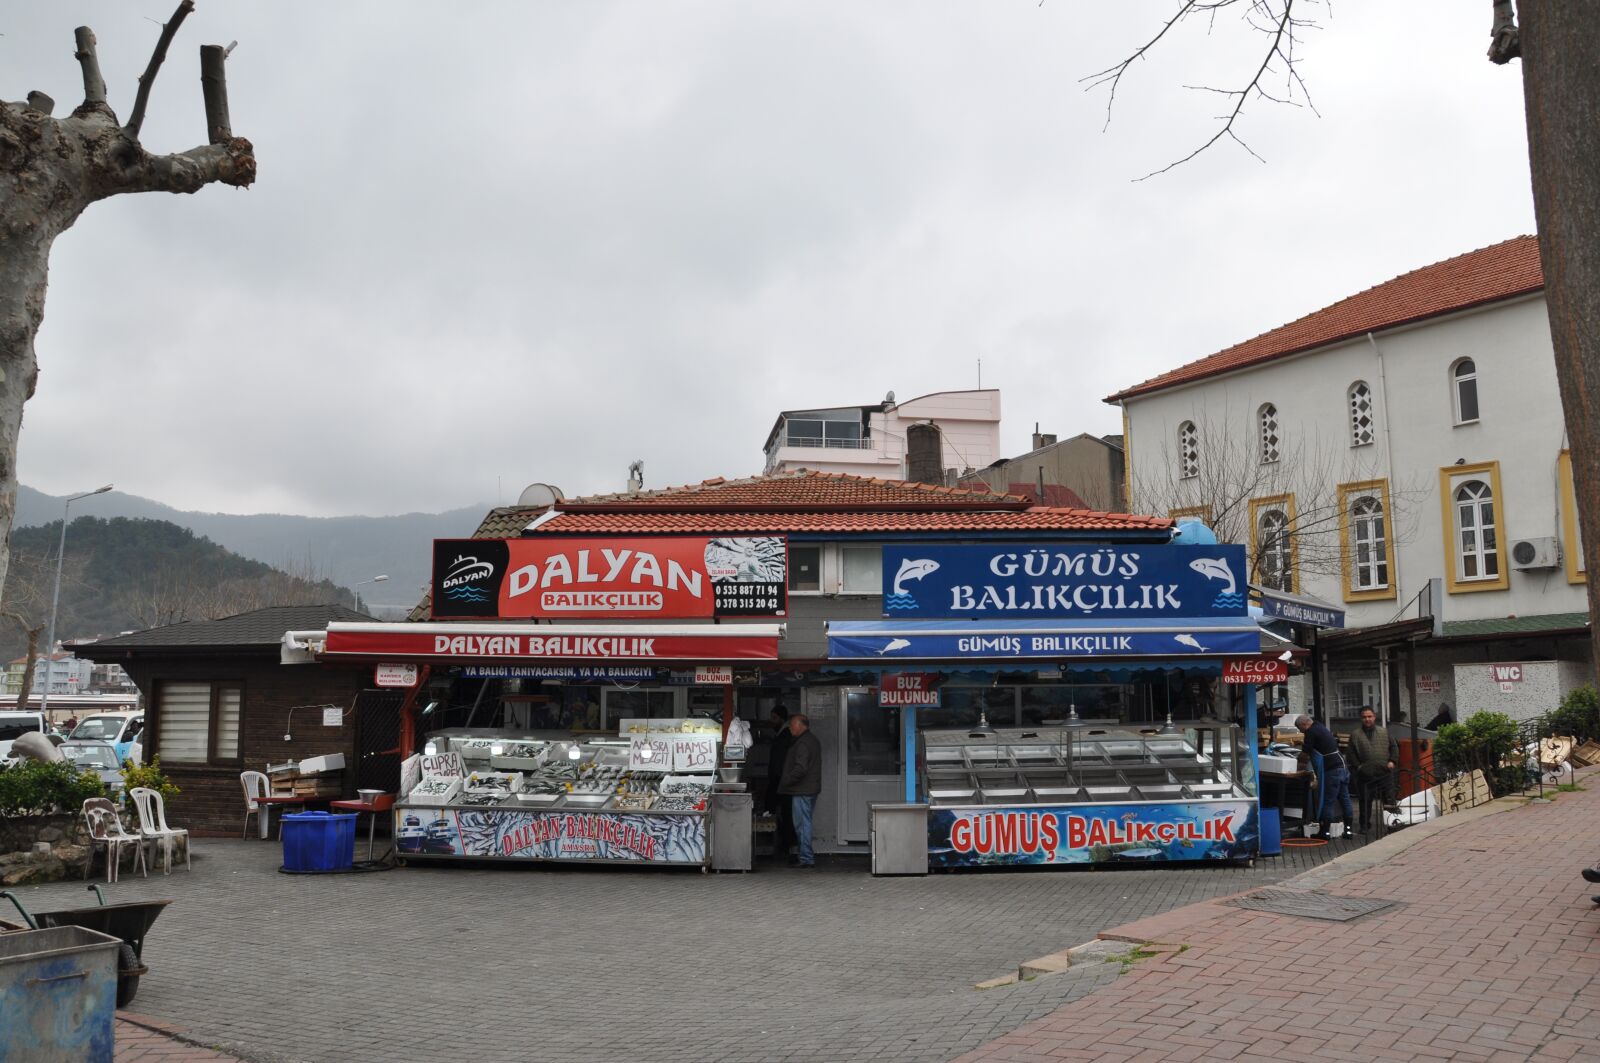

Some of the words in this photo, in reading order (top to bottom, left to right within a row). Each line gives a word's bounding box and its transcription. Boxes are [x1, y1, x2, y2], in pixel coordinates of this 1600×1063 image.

[509, 548, 702, 598] DALYAN
[989, 549, 1140, 580] GÜMÜŞ
[443, 570, 488, 589] DALYAN
[716, 585, 721, 595] 0
[722, 585, 737, 595] 535
[740, 585, 754, 595] 887
[756, 585, 765, 595] 71
[768, 585, 778, 596] 94
[950, 584, 1182, 614] BALIKÇILIK
[544, 593, 661, 610] BALIKÇILIK
[716, 599, 721, 608] 0
[722, 599, 737, 608] 378
[740, 599, 754, 608] 315
[756, 599, 766, 608] 20
[768, 599, 778, 609] 42
[1283, 603, 1302, 620] GÜMÜŞ
[434, 635, 520, 655] DALYAN
[528, 636, 656, 657] BALIKÇILIK
[958, 635, 1021, 657] GÜMÜŞ
[1032, 636, 1132, 653] BALIKÇILIK
[465, 667, 476, 676] YA
[510, 666, 577, 677] TANIYACAKSIN,
[579, 667, 591, 676] YA
[594, 667, 606, 676] DA
[1230, 661, 1278, 672] NECO
[1496, 666, 1520, 680] WC
[897, 676, 921, 689] BUZ
[880, 691, 938, 704] BULUNUR
[502, 817, 561, 856] DALYAN
[567, 816, 657, 860] BALIKÇILIK
[951, 813, 1058, 862] GÜMÜŞ
[1068, 815, 1235, 849] BALIKÇILIK
